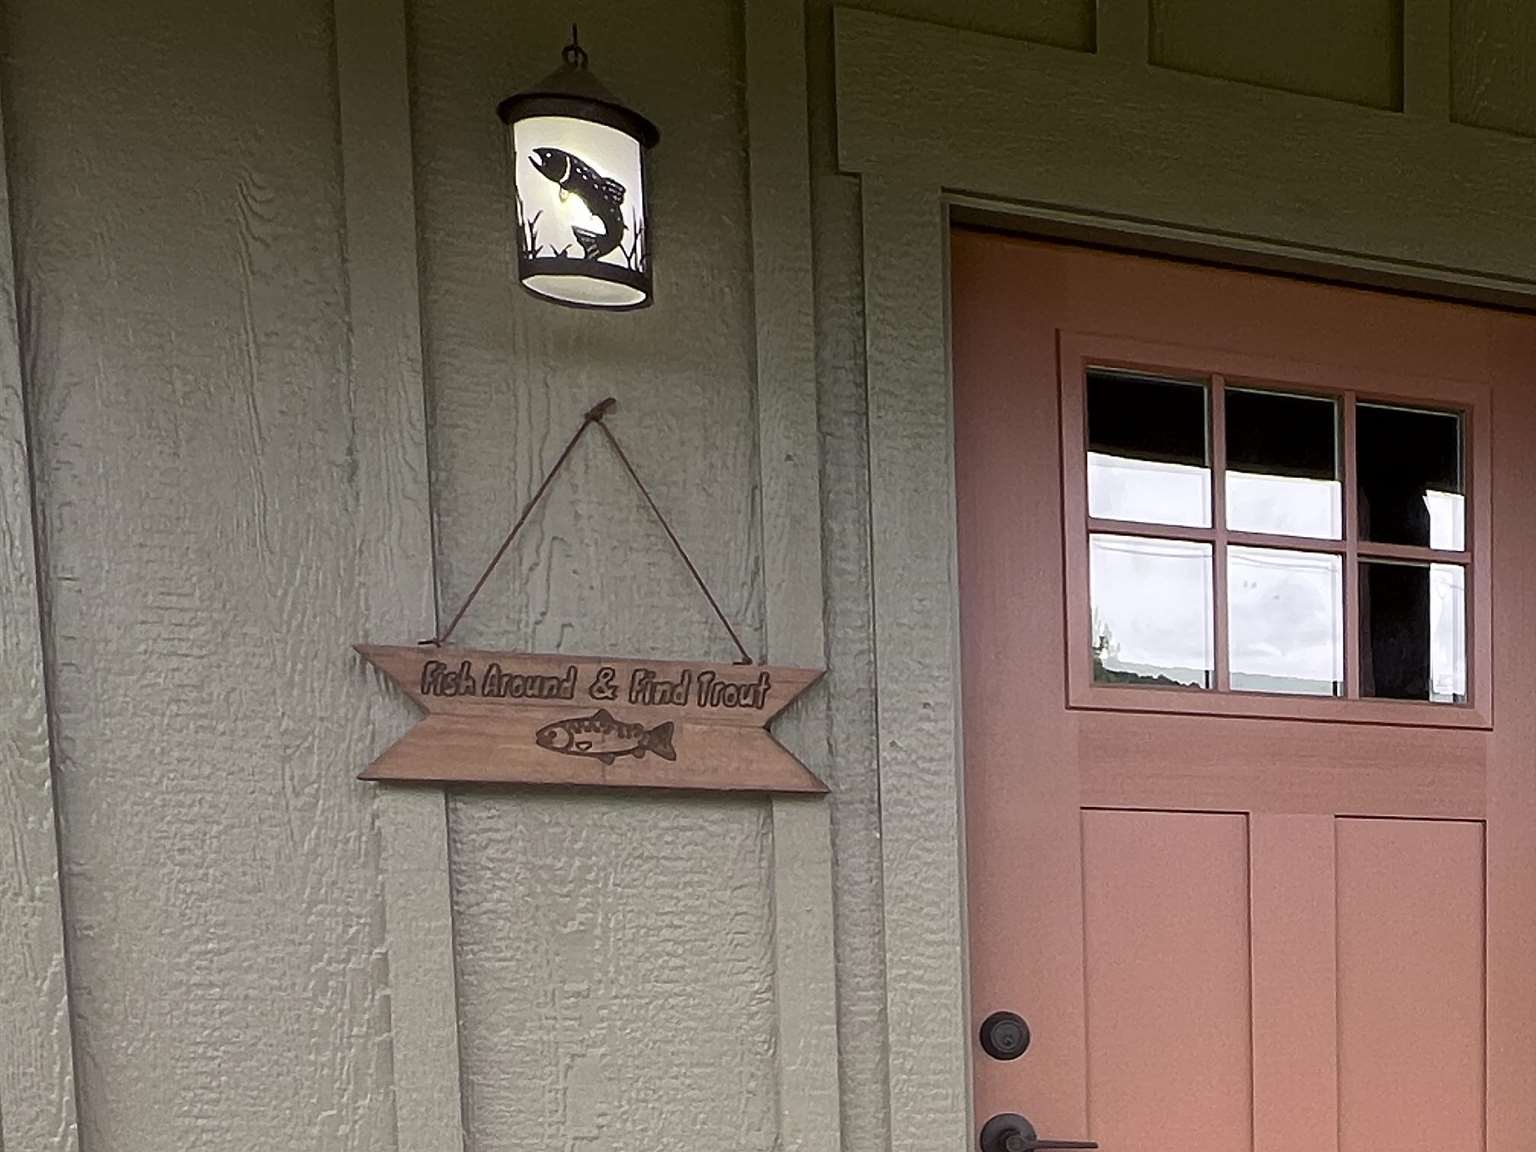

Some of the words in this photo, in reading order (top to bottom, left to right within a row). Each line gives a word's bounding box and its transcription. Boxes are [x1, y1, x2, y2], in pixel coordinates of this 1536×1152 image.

[420, 660, 476, 697] Fish
[481, 661, 578, 700] Around
[588, 667, 619, 700] &
[628, 669, 690, 707] Find
[696, 671, 772, 710] Trout
